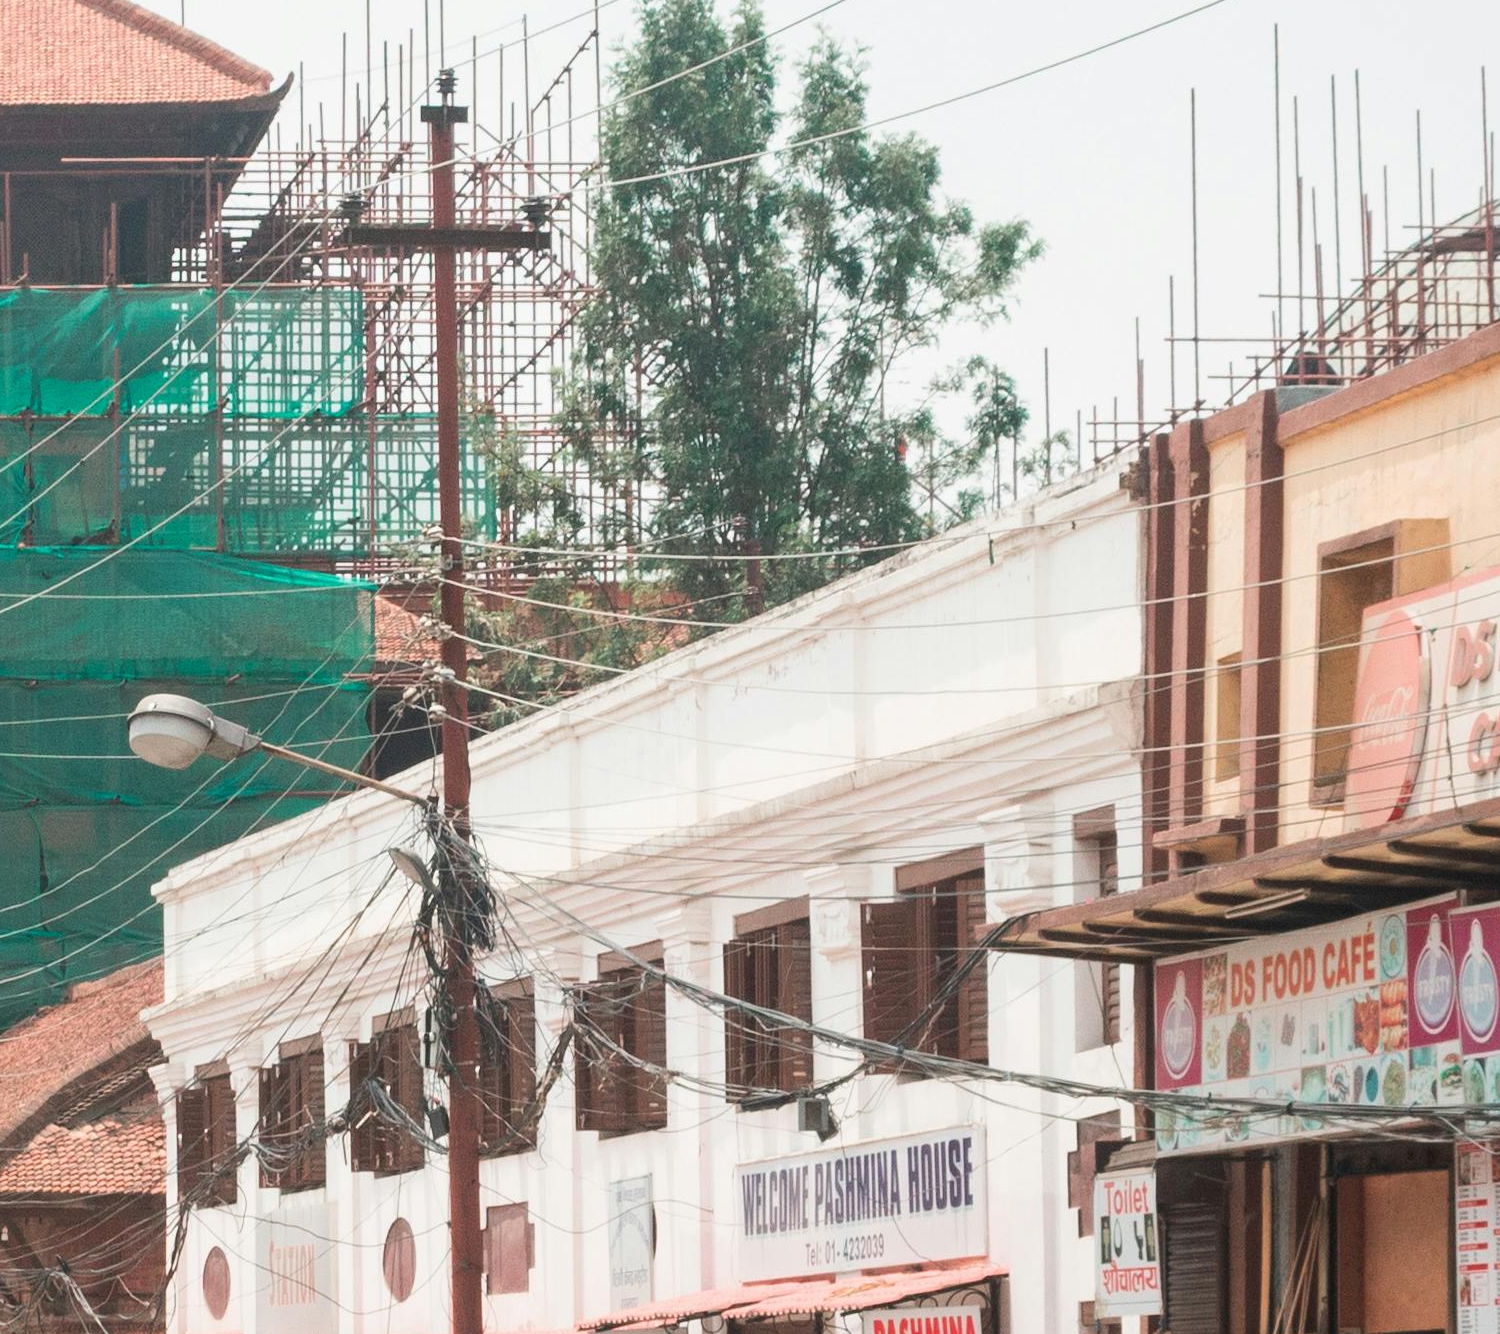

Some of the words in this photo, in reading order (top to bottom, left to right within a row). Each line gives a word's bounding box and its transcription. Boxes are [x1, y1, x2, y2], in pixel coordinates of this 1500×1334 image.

[1451, 620, 1494, 687] DS
[1231, 964, 1255, 1008] DS
[1262, 949, 1318, 1002] FOOD
[1321, 922, 1375, 989] CAFÉ
[742, 1165, 809, 1237] WELCOME
[814, 1149, 901, 1228] PASHMINA
[907, 1137, 974, 1214] HOUSE
[1104, 1180, 1148, 1215] Toilet
[268, 1239, 316, 1306] STATION
[806, 1243, 822, 1267] Tel:
[843, 1233, 885, 1262] 4232039
[1103, 1259, 1160, 1295] शौचालय
